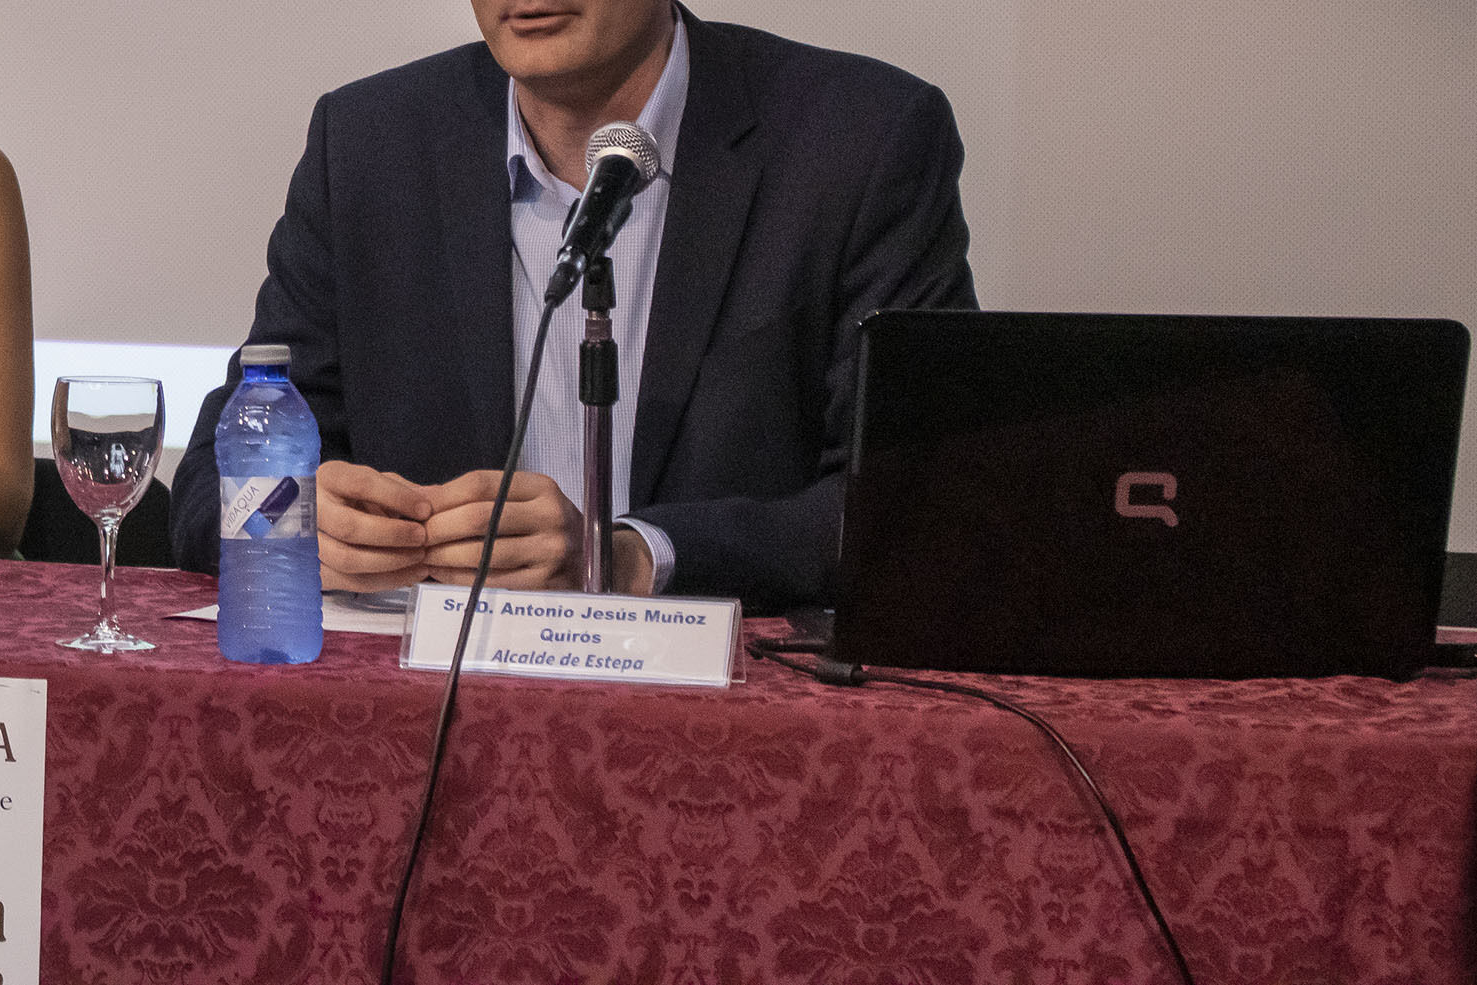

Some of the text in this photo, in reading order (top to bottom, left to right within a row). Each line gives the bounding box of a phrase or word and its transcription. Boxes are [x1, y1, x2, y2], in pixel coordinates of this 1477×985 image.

[500, 601, 575, 619] Antonio
[580, 606, 637, 622] Jesús
[644, 609, 706, 626] Muñoz
[539, 627, 602, 644] Quirós
[491, 648, 645, 672] Alcalde de Estepa
